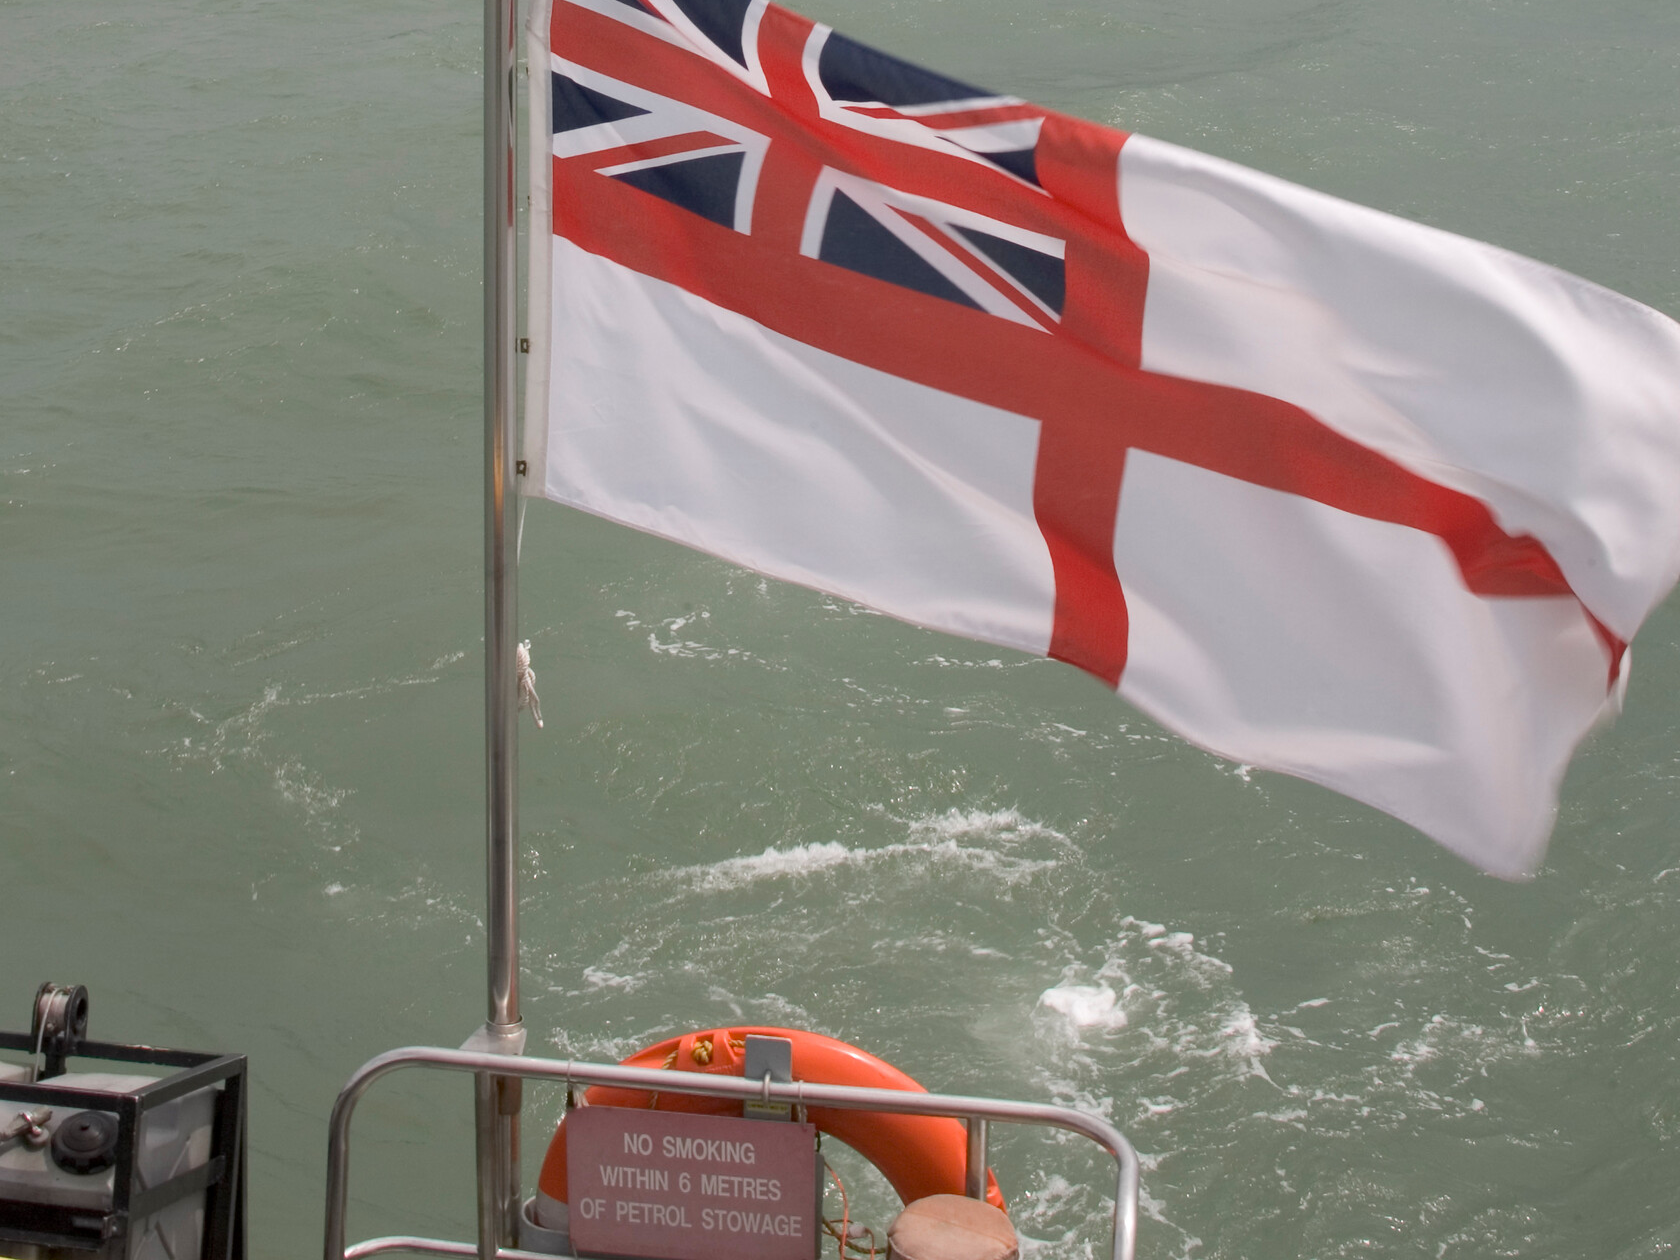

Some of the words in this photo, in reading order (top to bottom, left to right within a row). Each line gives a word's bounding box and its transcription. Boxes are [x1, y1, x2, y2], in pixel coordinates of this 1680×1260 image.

[623, 1132, 653, 1156] NO
[662, 1135, 756, 1165] SMOKING
[600, 1165, 669, 1191] WITHIN
[678, 1172, 691, 1193] 6
[701, 1174, 782, 1201] METRES
[580, 1198, 607, 1219] OF
[616, 1201, 692, 1228] PETROL
[702, 1208, 802, 1237] STOWAGE
